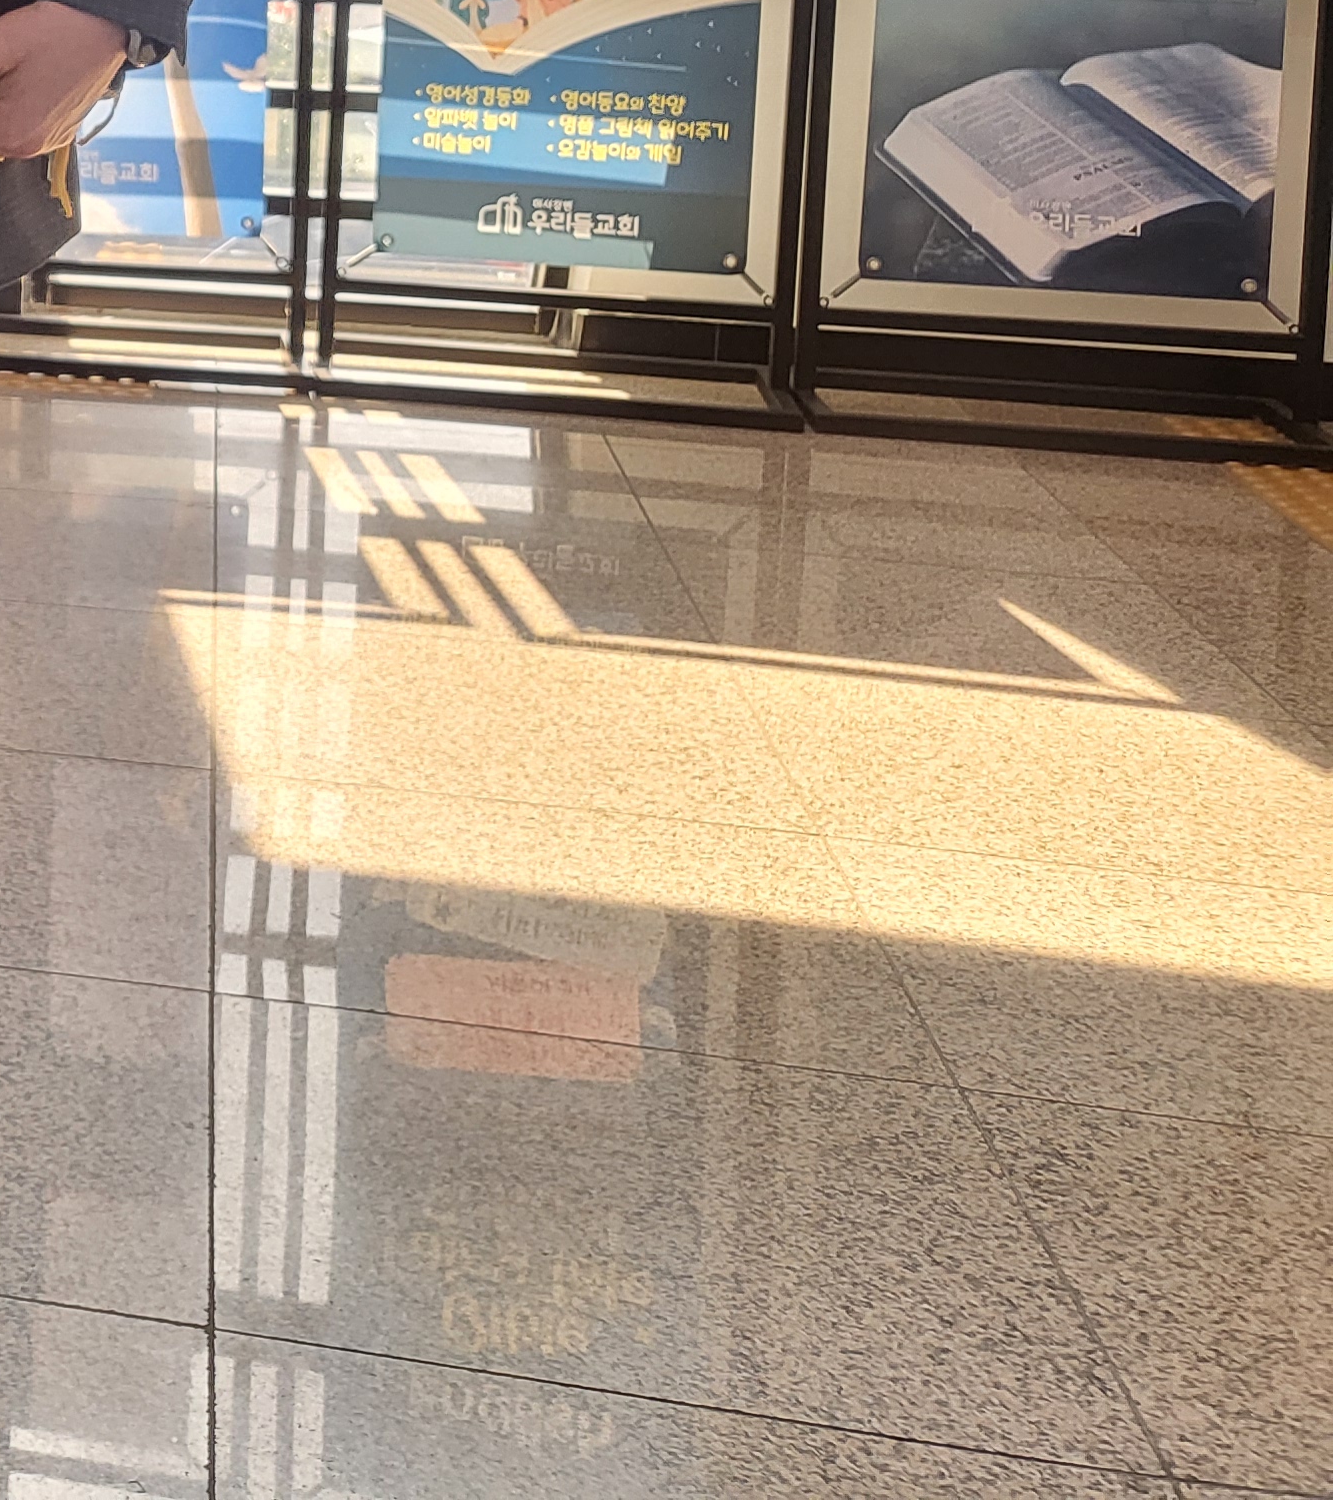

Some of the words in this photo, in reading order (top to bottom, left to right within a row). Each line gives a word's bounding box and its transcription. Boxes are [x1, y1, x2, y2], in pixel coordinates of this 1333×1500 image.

[425, 82, 531, 108] 영어성경동화
[79, 160, 159, 185] 리들교회
[527, 209, 640, 241] 우리들교회
